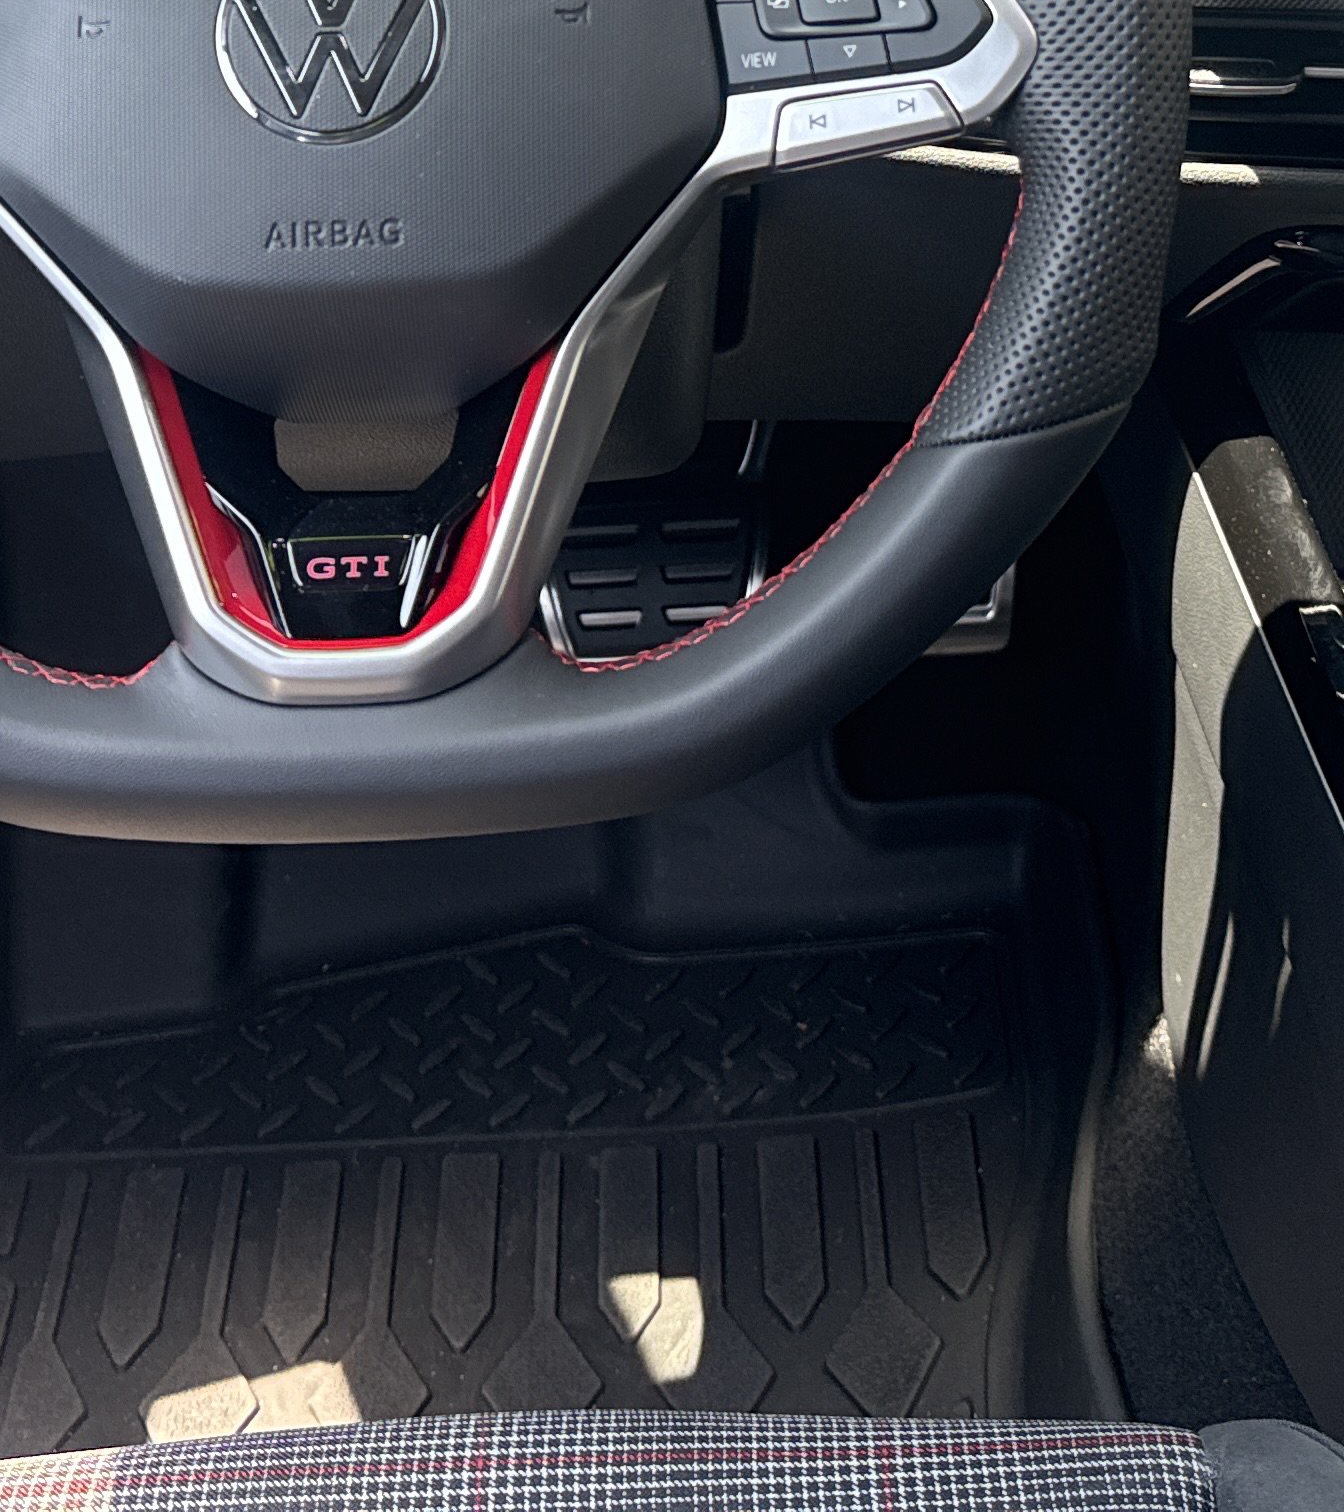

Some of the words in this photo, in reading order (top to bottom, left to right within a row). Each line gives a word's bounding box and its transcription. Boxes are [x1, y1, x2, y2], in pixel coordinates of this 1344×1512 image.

[741, 52, 776, 69] VIEW
[264, 218, 405, 251] AIRBAG
[306, 555, 390, 580] GTI
